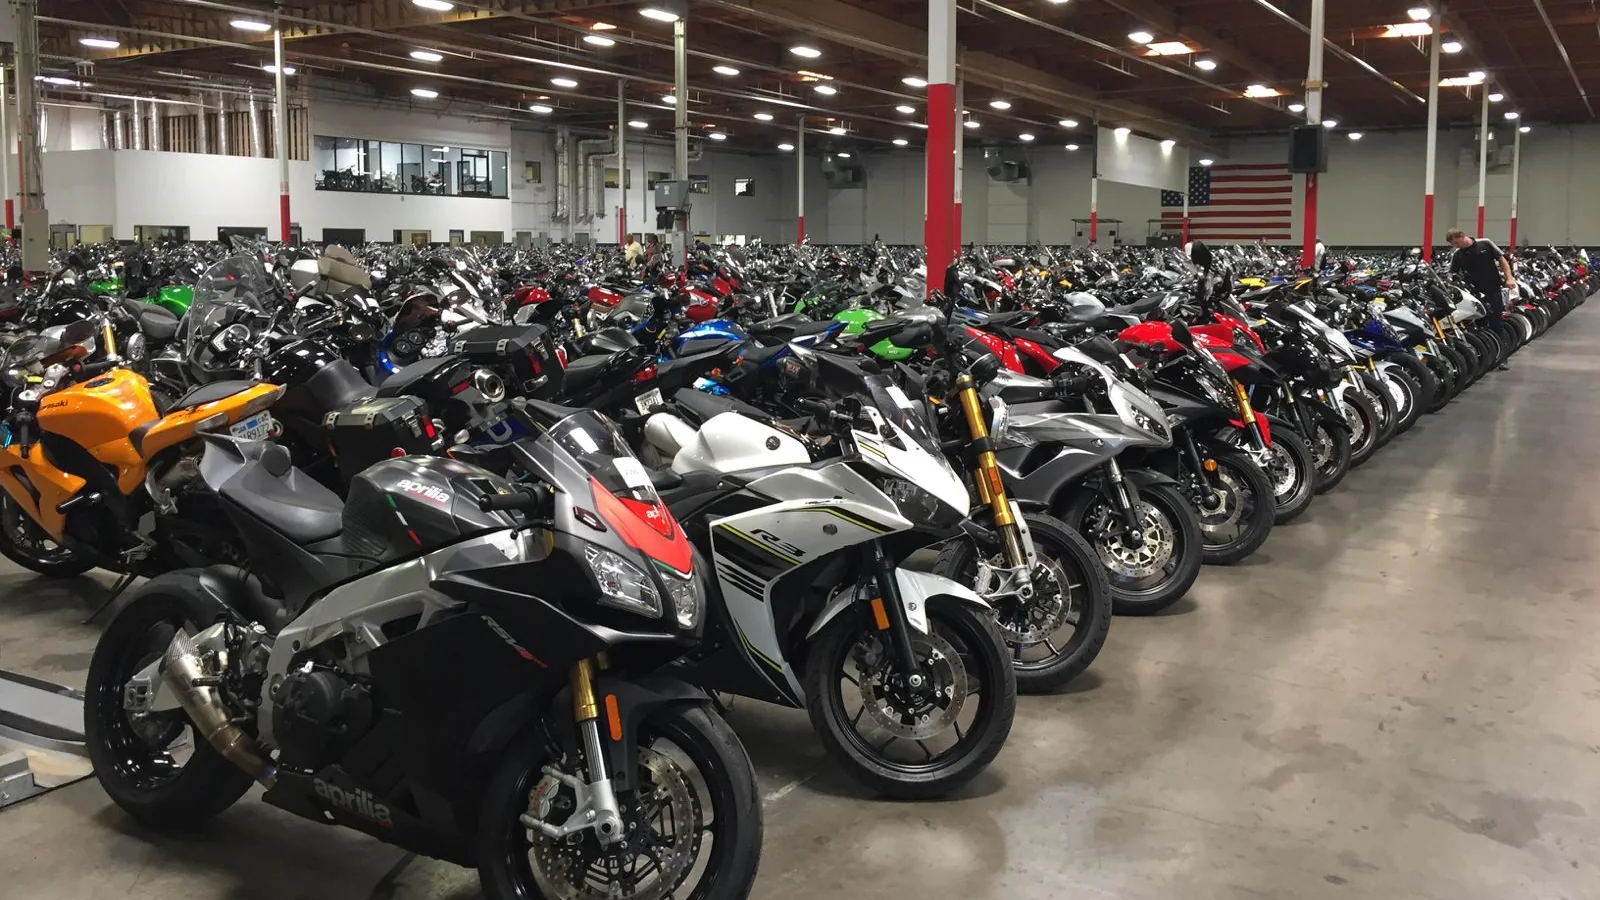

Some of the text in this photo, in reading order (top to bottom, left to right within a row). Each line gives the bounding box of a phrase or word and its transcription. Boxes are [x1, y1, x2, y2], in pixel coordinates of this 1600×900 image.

[396, 479, 451, 503] aprilia
[749, 528, 807, 557] R3
[313, 777, 393, 824] aprilia
